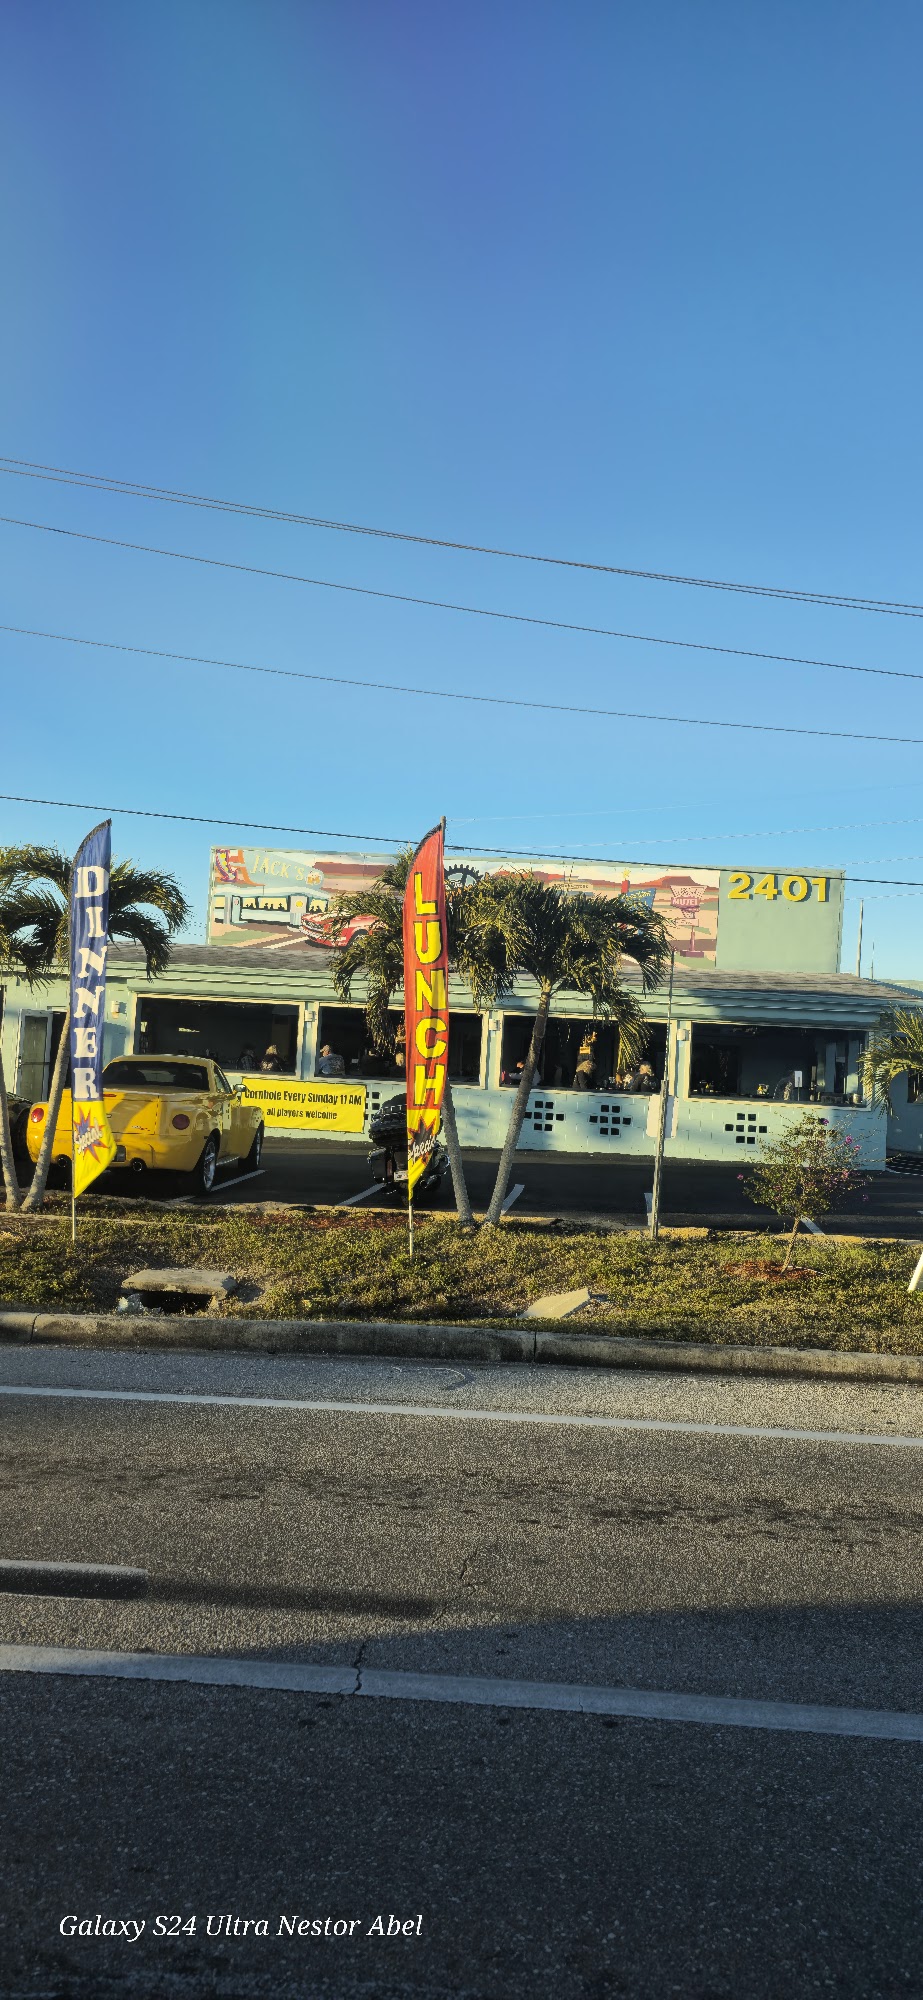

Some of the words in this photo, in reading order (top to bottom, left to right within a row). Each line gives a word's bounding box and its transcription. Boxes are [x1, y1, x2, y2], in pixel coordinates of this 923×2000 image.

[728, 872, 828, 902] 2401
[74, 866, 109, 1099] DINNER
[413, 871, 447, 1107] LUNCH
[244, 1089, 281, 1101] Cornhole
[283, 1091, 306, 1104] Every
[308, 1092, 338, 1106] Sunday
[340, 1094, 348, 1105] 11
[348, 1094, 362, 1106] AM
[266, 1107, 276, 1117] all
[277, 1108, 304, 1119] players
[305, 1110, 338, 1120] welcome
